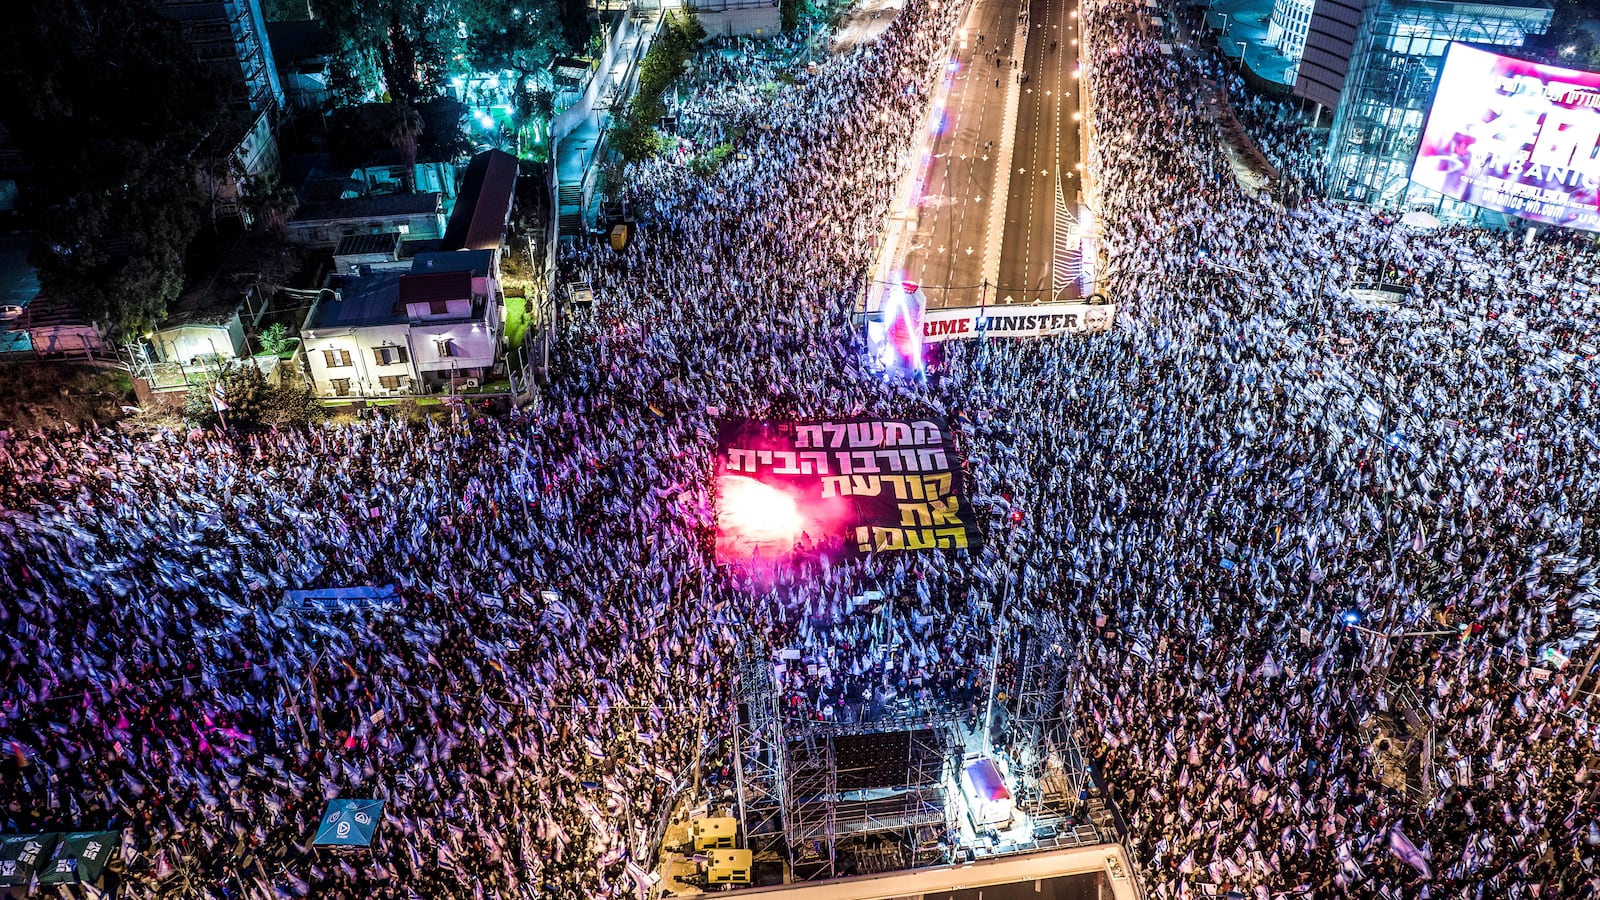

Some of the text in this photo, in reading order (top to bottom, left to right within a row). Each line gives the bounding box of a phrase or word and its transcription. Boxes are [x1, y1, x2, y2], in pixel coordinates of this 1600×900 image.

[923, 313, 1078, 337] RIME MINISTER
[795, 420, 942, 448] ממשלת
[726, 448, 949, 474] חורבן הבית
[821, 472, 953, 500] קורעת
[897, 495, 963, 527] את
[855, 526, 968, 553] העם!
